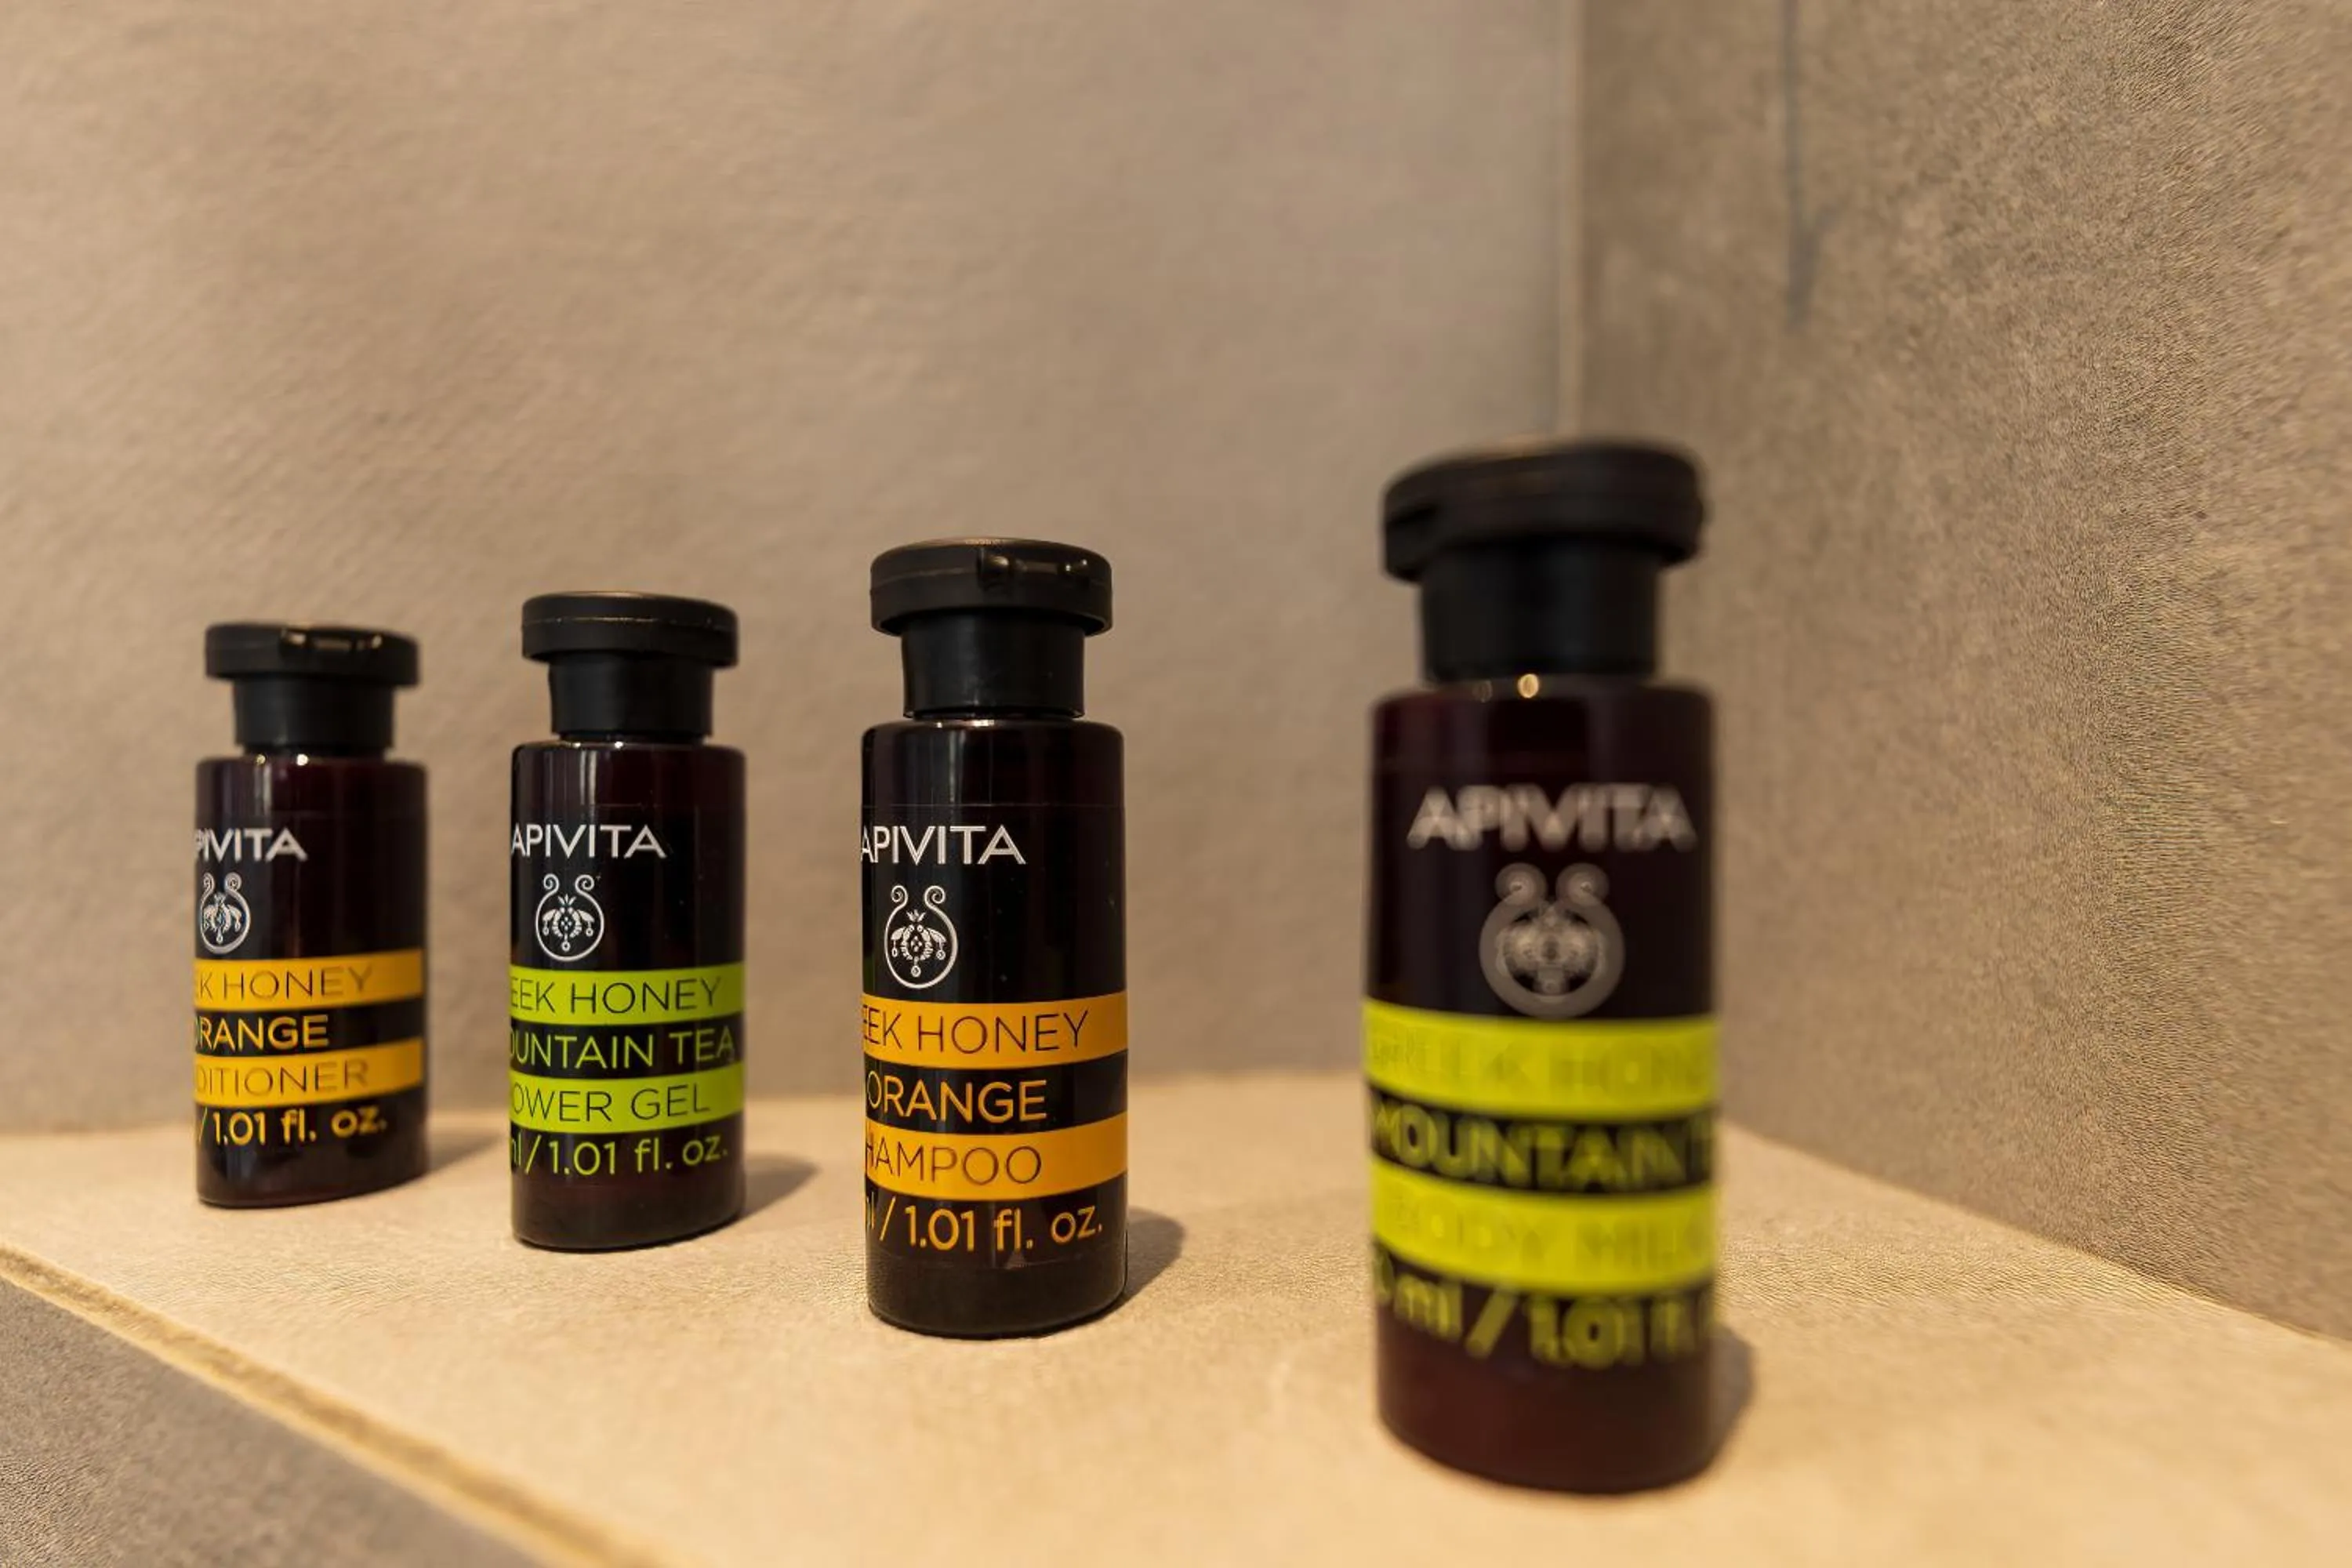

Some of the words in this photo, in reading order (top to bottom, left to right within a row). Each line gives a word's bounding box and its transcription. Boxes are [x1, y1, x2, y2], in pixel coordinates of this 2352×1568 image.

[1407, 784, 1697, 851] APIVITA
[512, 824, 667, 859] APIVITA
[860, 825, 1026, 865] APIVITA
[223, 966, 372, 1001] HONEY
[571, 977, 722, 1014] HONEY
[669, 1025, 735, 1066] TEA
[918, 1009, 1088, 1054] HONEY
[631, 1083, 710, 1118] GEL
[866, 1070, 1047, 1123] ORANGE
[212, 1111, 265, 1145] 1.01
[280, 1108, 316, 1145] fl.
[331, 1106, 387, 1138] oz.
[549, 1140, 616, 1175] 1.01
[634, 1137, 673, 1173] fl.
[683, 1135, 728, 1165] oz.
[905, 1205, 975, 1251] 1.01
[994, 1208, 1033, 1250] fl.
[1051, 1205, 1102, 1244] oz.
